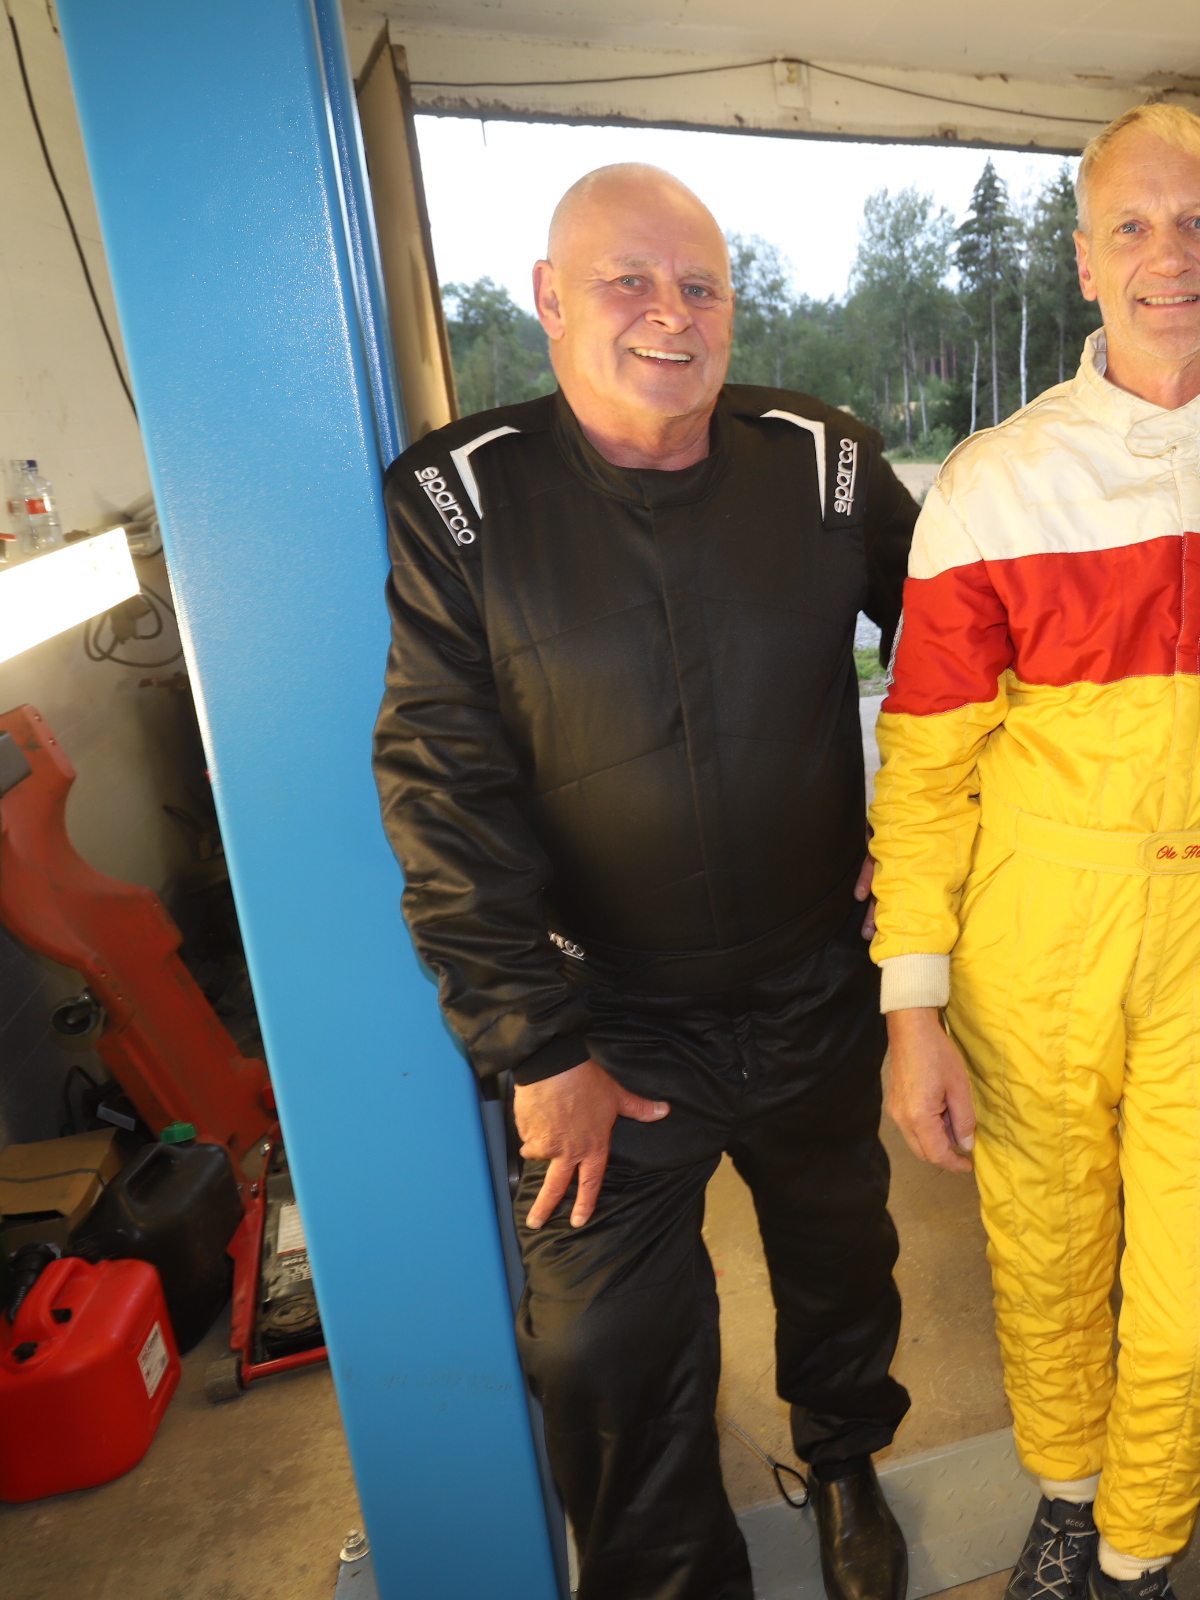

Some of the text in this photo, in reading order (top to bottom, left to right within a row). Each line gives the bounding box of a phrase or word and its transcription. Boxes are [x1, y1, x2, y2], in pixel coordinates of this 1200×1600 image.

[414, 466, 476, 547] sparco
[834, 438, 858, 516] sparco
[1155, 845, 1178, 860] Ole
